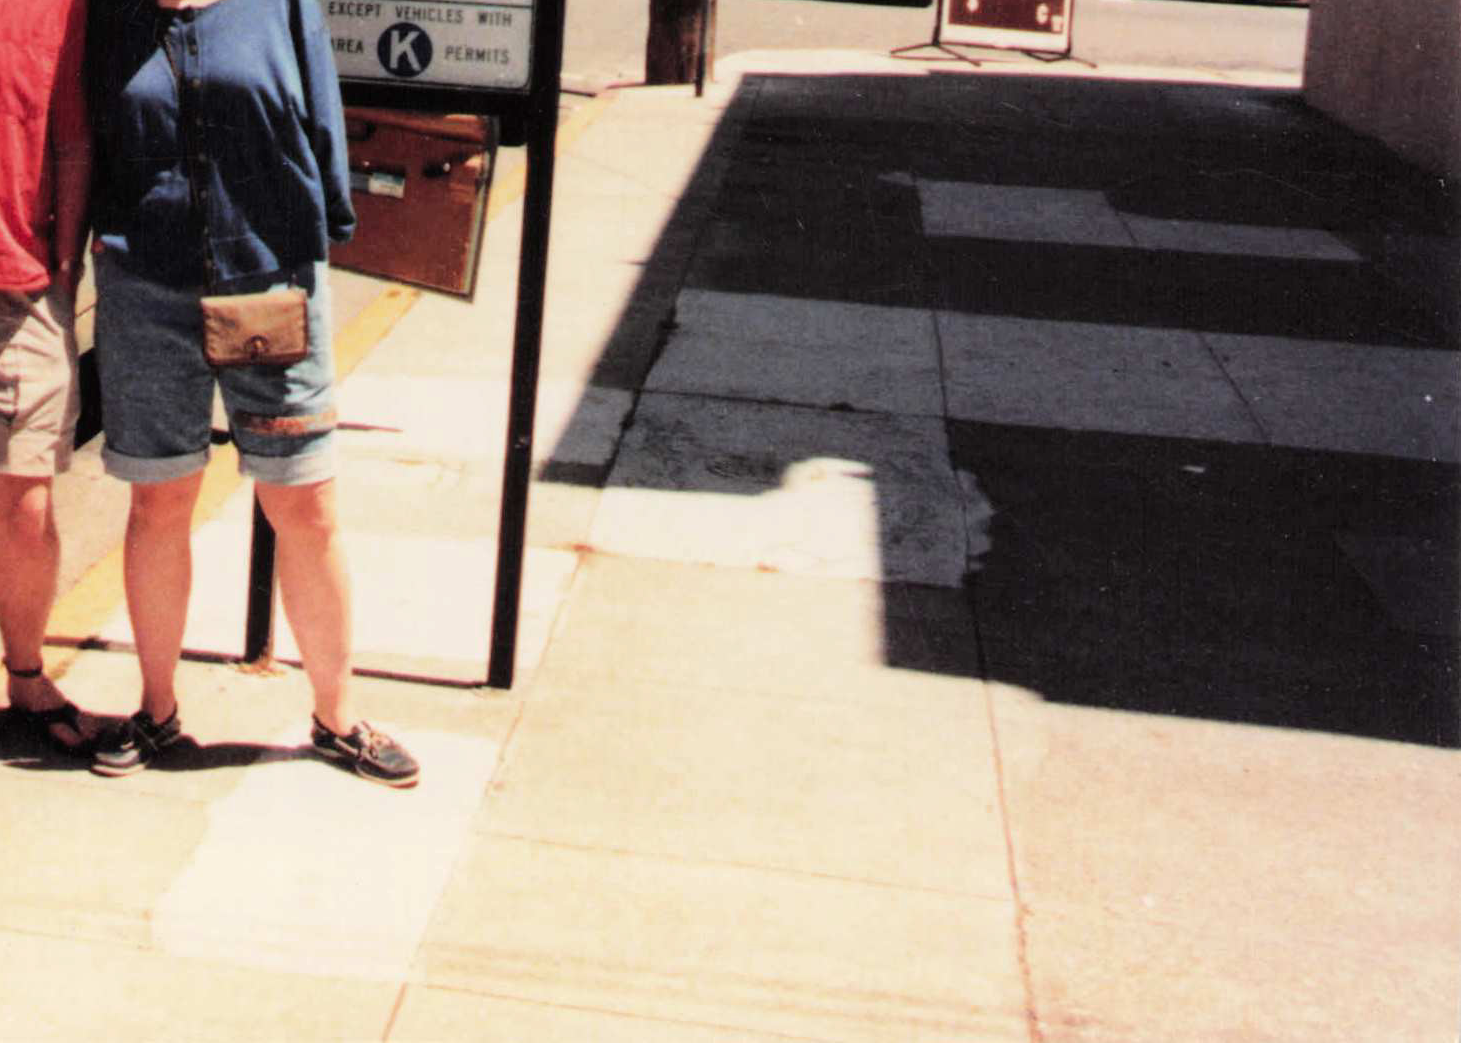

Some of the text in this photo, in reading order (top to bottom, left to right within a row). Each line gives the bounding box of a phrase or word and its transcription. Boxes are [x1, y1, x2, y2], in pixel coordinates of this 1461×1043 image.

[328, 1, 513, 28] EXCEPT VEHICLES WITH
[390, 29, 421, 72] K
[445, 45, 510, 65] PERMITS
